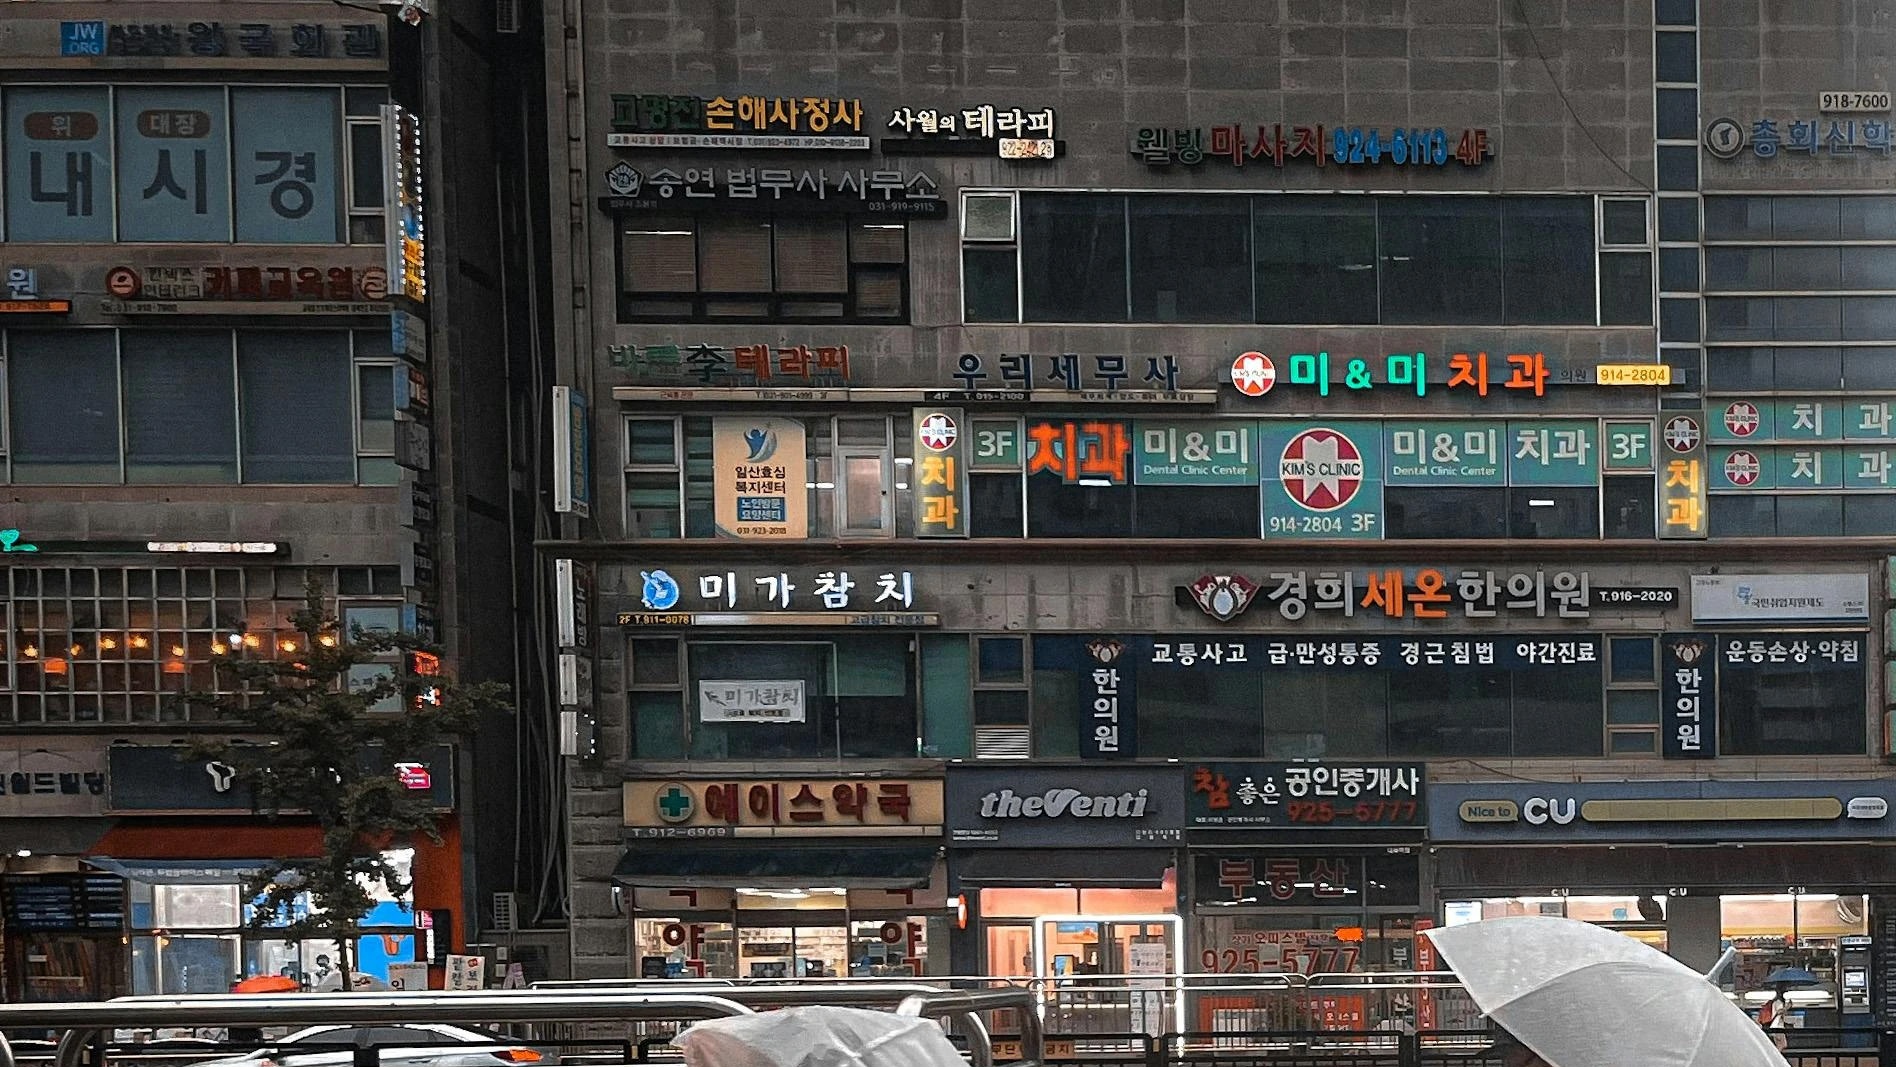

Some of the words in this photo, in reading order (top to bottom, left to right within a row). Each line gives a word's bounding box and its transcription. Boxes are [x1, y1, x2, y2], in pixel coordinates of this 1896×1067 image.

[706, 95, 863, 132] 손해사정사
[1823, 94, 1888, 108] 918-7600
[50, 114, 71, 137] 위
[149, 113, 199, 136] 대장
[888, 108, 955, 134] 사월의
[962, 105, 1054, 138] 테라피
[1752, 119, 1895, 158] 총회신학
[1138, 128, 1202, 164] 웰빙
[1211, 123, 1326, 167] 마사지
[29, 149, 316, 219] 내시경
[649, 167, 716, 198] 송연
[727, 167, 829, 200] 법무사
[837, 168, 939, 200] 사무소
[953, 353, 1181, 391] 우리세무사
[1447, 351, 1550, 397] 치과
[1600, 368, 1667, 382] 914-2804
[1793, 403, 1892, 436] 치과
[977, 431, 1013, 456] 3F
[1027, 420, 1132, 483] 치과
[1144, 427, 1248, 464] 미&미
[1394, 427, 1497, 464] 미&미
[1515, 428, 1591, 466] 치과
[1612, 433, 1646, 459] 3F
[1144, 465, 1178, 476] Dental
[1181, 465, 1209, 476] Clinic
[1212, 465, 1248, 476] Center
[1282, 462, 1315, 476] KIM'S
[1318, 462, 1361, 476] CLINIC
[1393, 465, 1428, 477] Dental
[1430, 465, 1457, 477] Clinic
[1460, 465, 1496, 477] Center
[1791, 451, 1892, 485] 치과
[921, 456, 959, 530] 치과
[1665, 459, 1702, 532] 치과
[1270, 516, 1342, 533] 914-2804
[1351, 513, 1376, 532] 3F
[699, 571, 913, 609] 미가참치
[1152, 643, 1248, 665] 교통사고
[1400, 642, 1494, 665] 경근침법
[1516, 642, 1597, 664] 야간진료
[1093, 669, 1120, 752] 한의원
[1676, 668, 1702, 751] 한의원
[981, 788, 1148, 818] theVenti
[1237, 777, 1281, 805] 좋은
[1285, 766, 1420, 798] 공인중개사
[704, 783, 912, 824] 에이스약국
[1468, 806, 1495, 818] Nice
[1498, 806, 1511, 818] to
[1523, 797, 1576, 825] CU
[1218, 858, 1349, 900] 부동산
[1551, 887, 1569, 896] CU
[1669, 887, 1688, 896] CU
